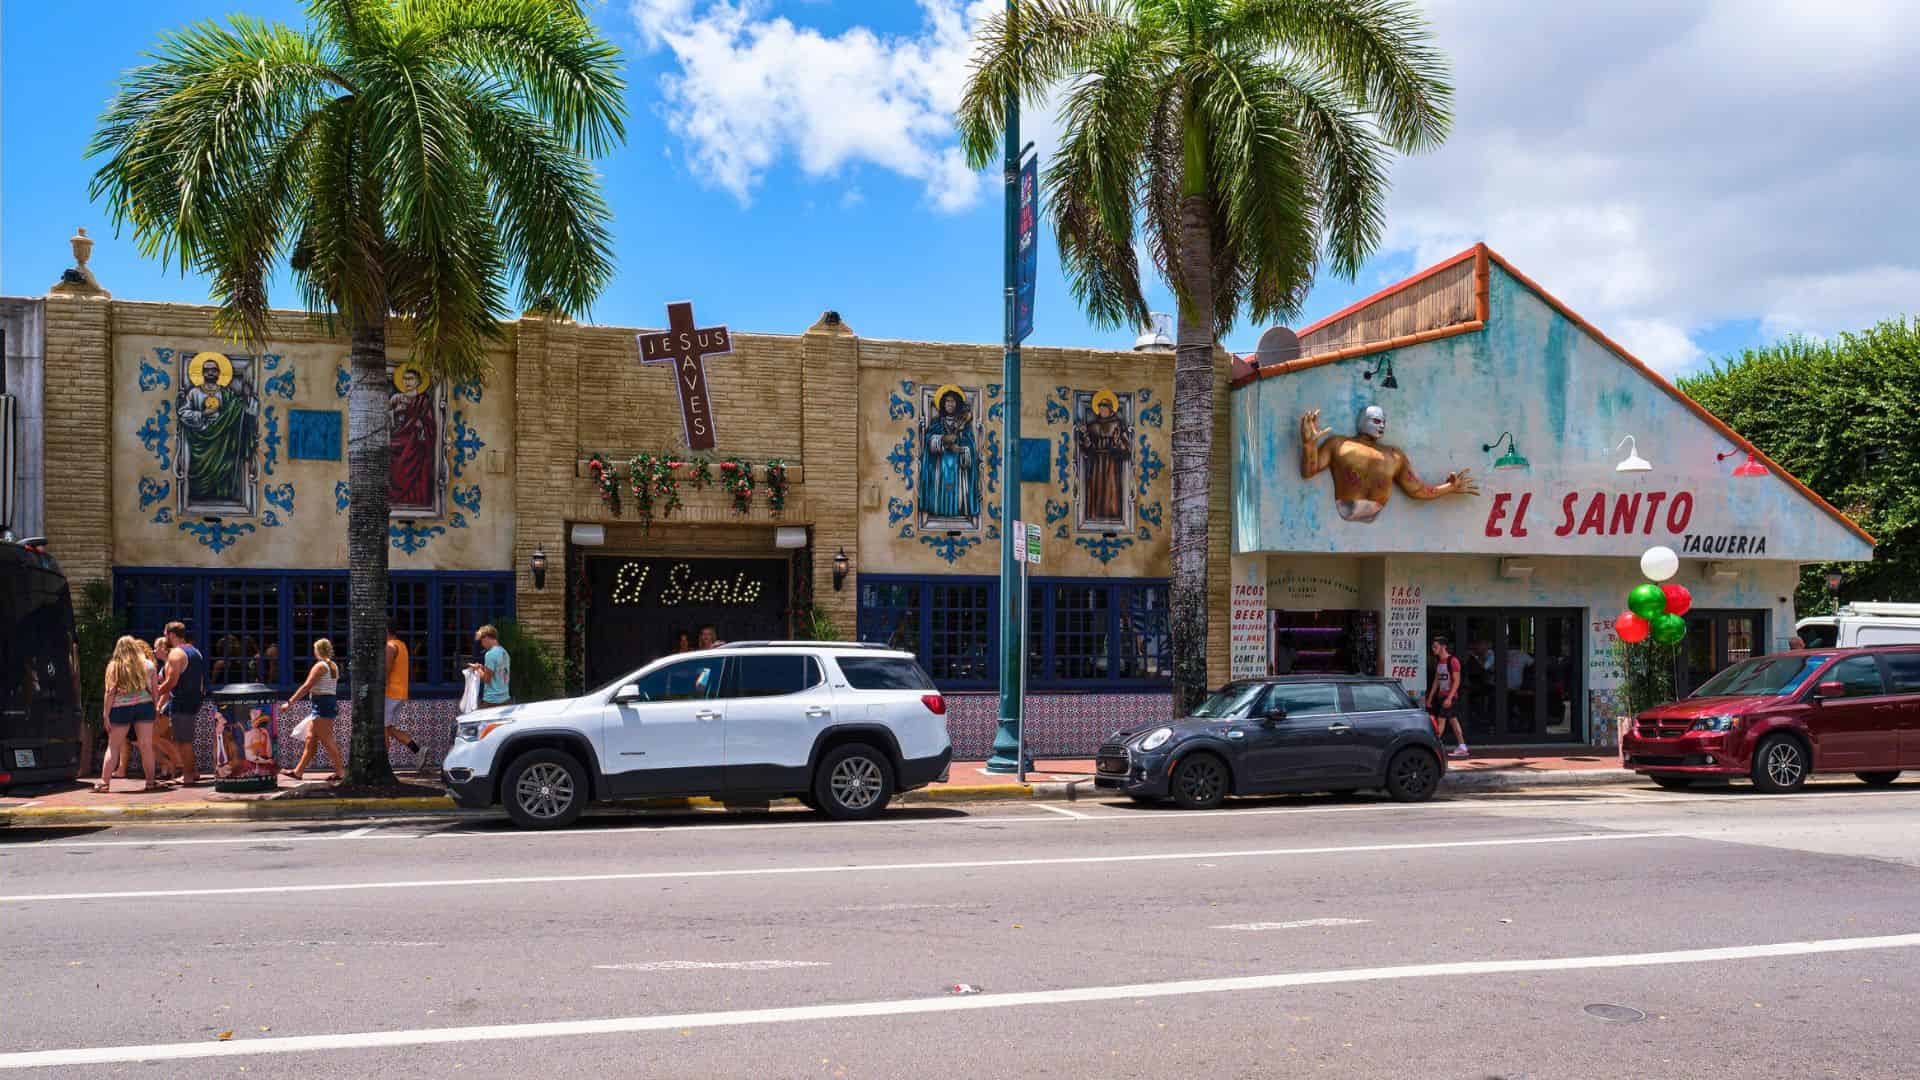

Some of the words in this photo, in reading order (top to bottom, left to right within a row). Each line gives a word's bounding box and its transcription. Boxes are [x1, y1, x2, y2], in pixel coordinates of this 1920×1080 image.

[649, 331, 725, 354] JESUS
[679, 332, 706, 436] SAVES
[1484, 492, 1533, 538] EL
[1554, 490, 1694, 537] SANTO
[1682, 534, 1767, 555] TAQUERIA
[612, 561, 650, 604] El
[660, 562, 761, 606] Santo
[1234, 584, 1265, 597] TACOS
[1391, 586, 1421, 598] TACO
[1234, 609, 1265, 620] BEER
[1407, 612, 1420, 621] OFF
[1407, 628, 1420, 637] OFF
[1233, 655, 1255, 664] COME
[1257, 655, 1267, 664] IN
[1391, 666, 1418, 678] FREE
